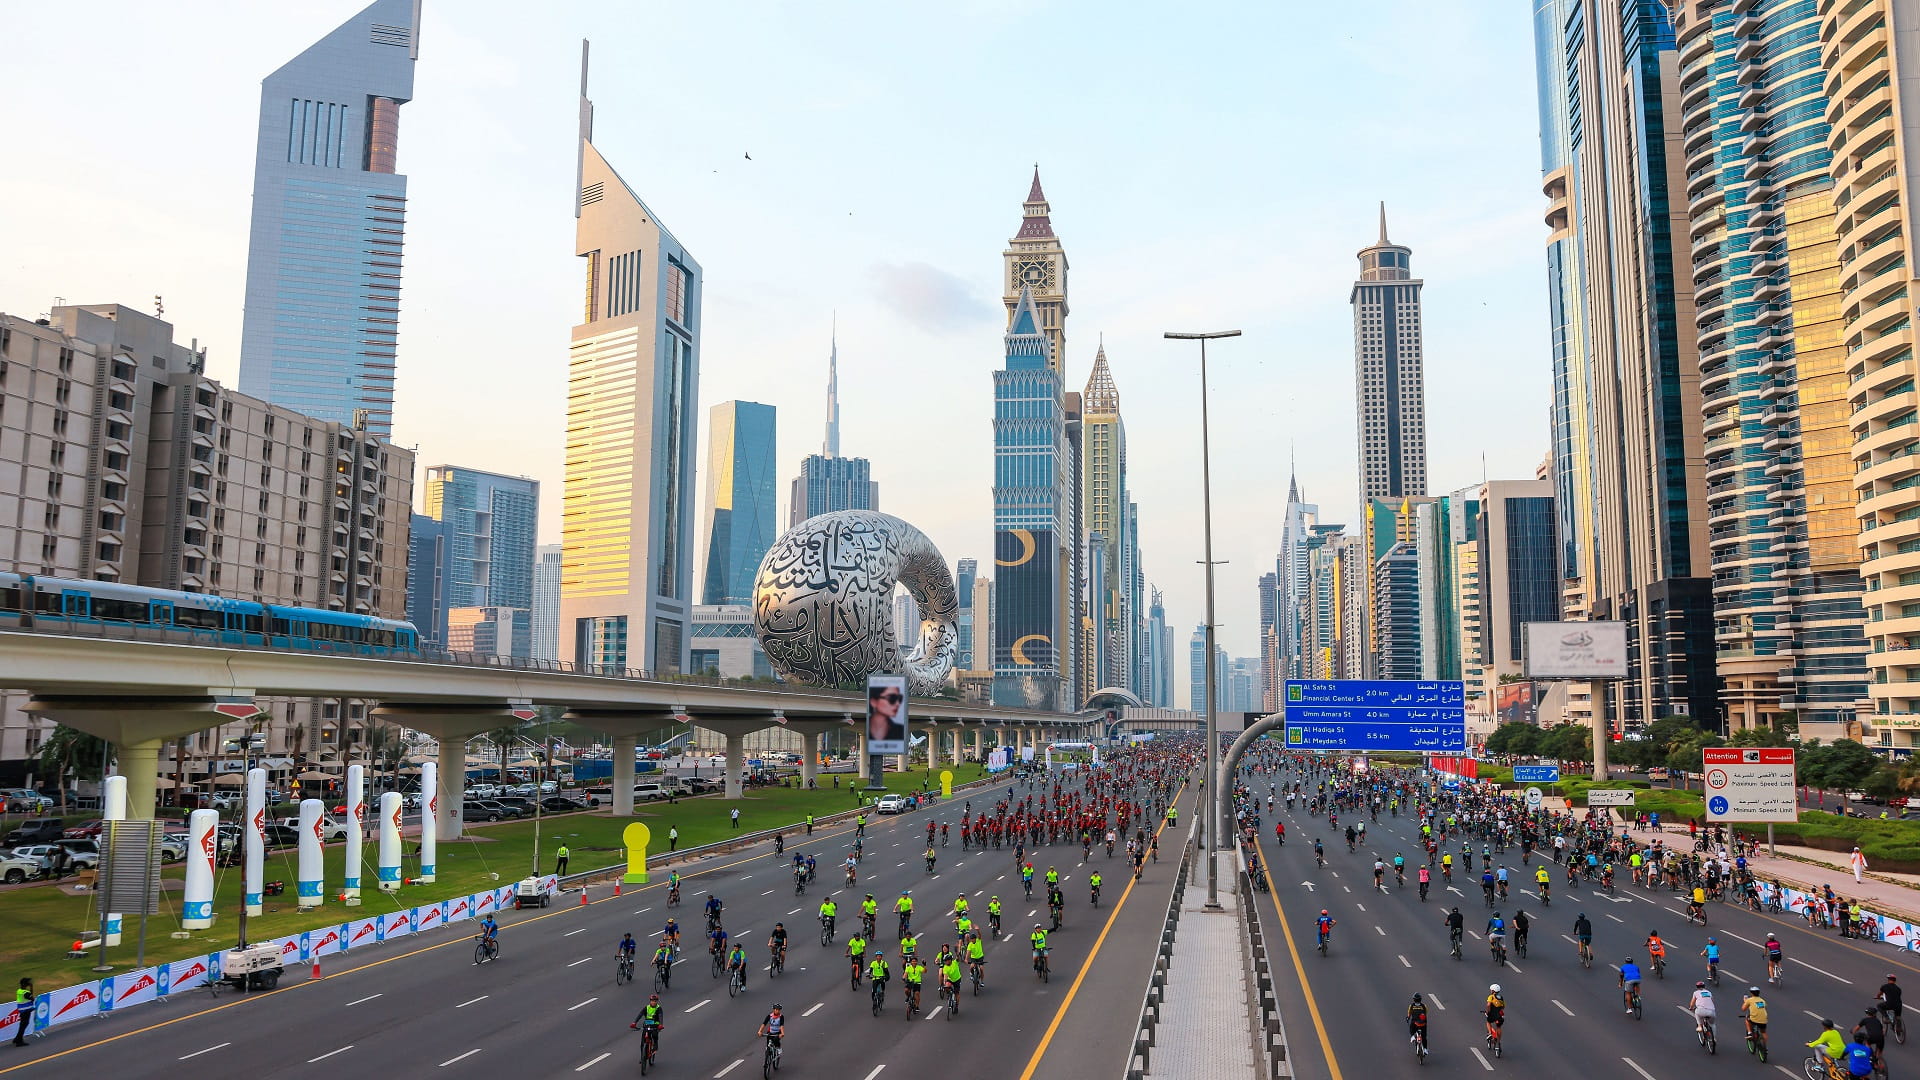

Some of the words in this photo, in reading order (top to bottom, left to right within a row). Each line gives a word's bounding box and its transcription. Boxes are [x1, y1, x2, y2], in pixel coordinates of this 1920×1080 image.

[1441, 684, 1461, 692] شارع
[1391, 694, 1412, 704] المالي
[1416, 694, 1438, 702] المركز
[1441, 695, 1462, 703] شارع
[1442, 711, 1462, 720] شارع
[1409, 726, 1439, 734] الحديقة
[1442, 727, 1462, 735] شارع
[1312, 738, 1337, 746] Meydan
[1414, 738, 1439, 746] الميدان
[1442, 738, 1462, 747] شارع
[206, 836, 215, 859] RTA
[282, 944, 294, 954] RTA
[187, 966, 201, 976] RTA
[135, 979, 150, 990] RTA
[73, 993, 90, 1005] RTA
